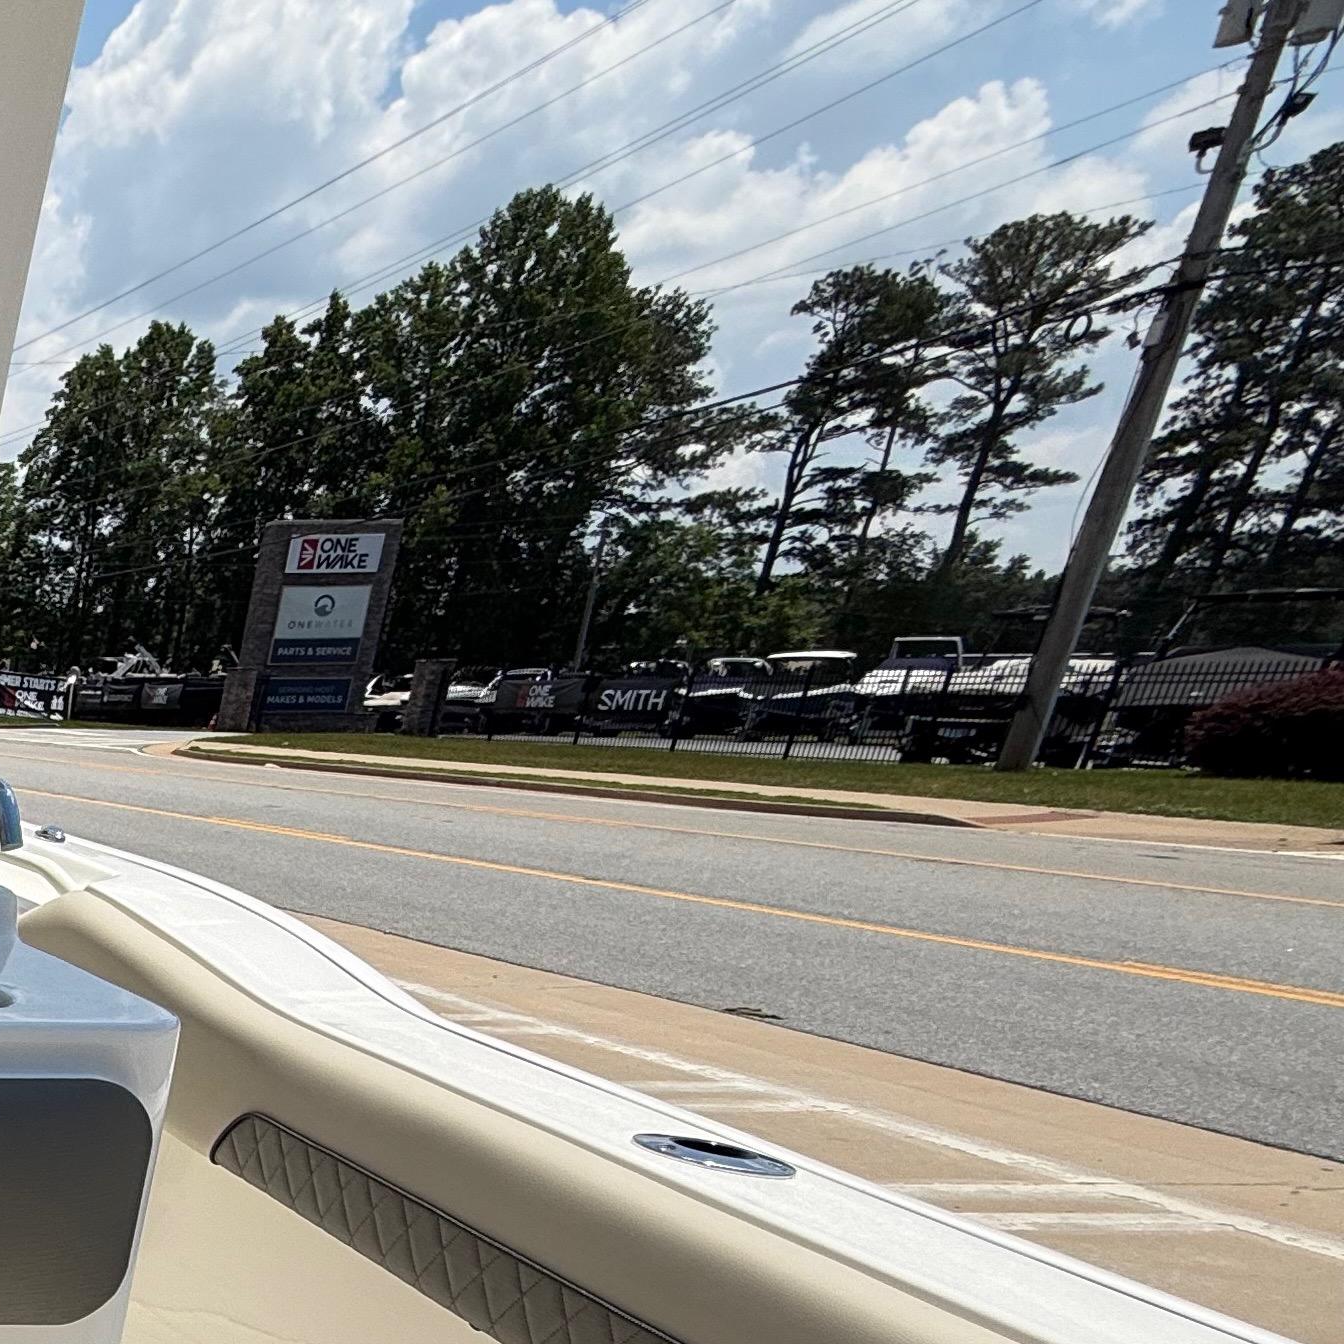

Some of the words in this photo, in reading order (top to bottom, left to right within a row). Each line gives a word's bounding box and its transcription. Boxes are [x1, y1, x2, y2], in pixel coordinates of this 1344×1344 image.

[320, 538, 359, 553] ONE
[316, 553, 369, 569] WAKE
[277, 647, 305, 656] PARTS
[315, 646, 352, 656] SERVICE
[23, 677, 56, 691] STARTS
[529, 685, 551, 696] ONE
[525, 696, 555, 708] WAKE
[597, 689, 667, 711] SMITH
